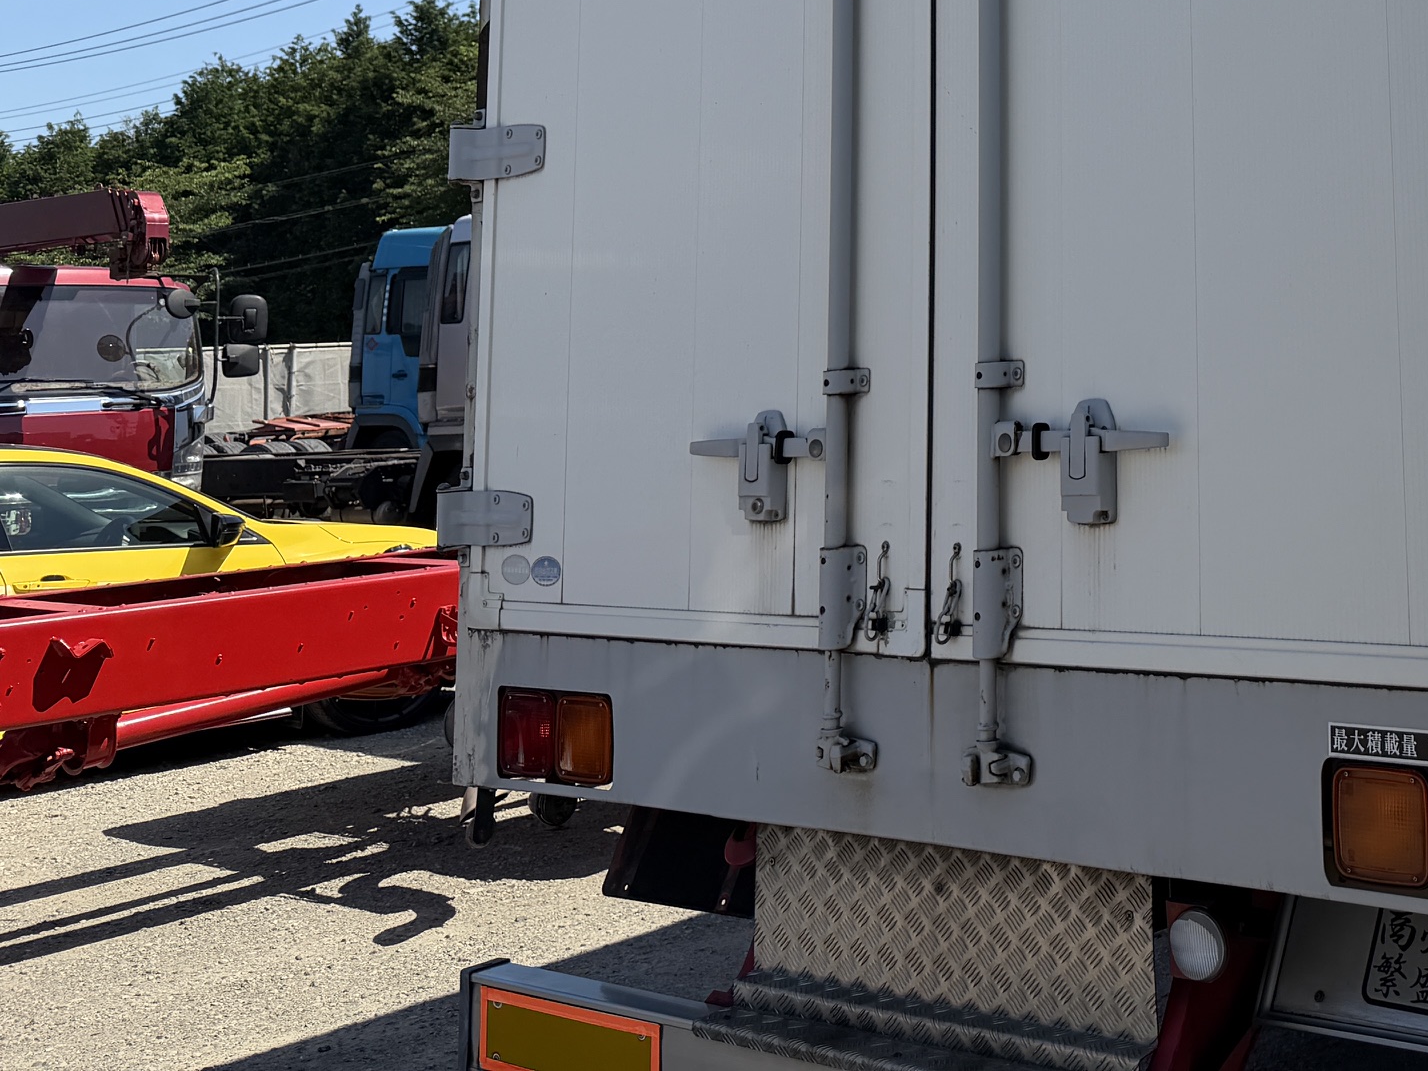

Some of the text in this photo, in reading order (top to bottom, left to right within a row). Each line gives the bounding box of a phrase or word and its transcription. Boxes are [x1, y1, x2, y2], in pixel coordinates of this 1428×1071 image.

[1333, 728, 1417, 757] 最大積載量
